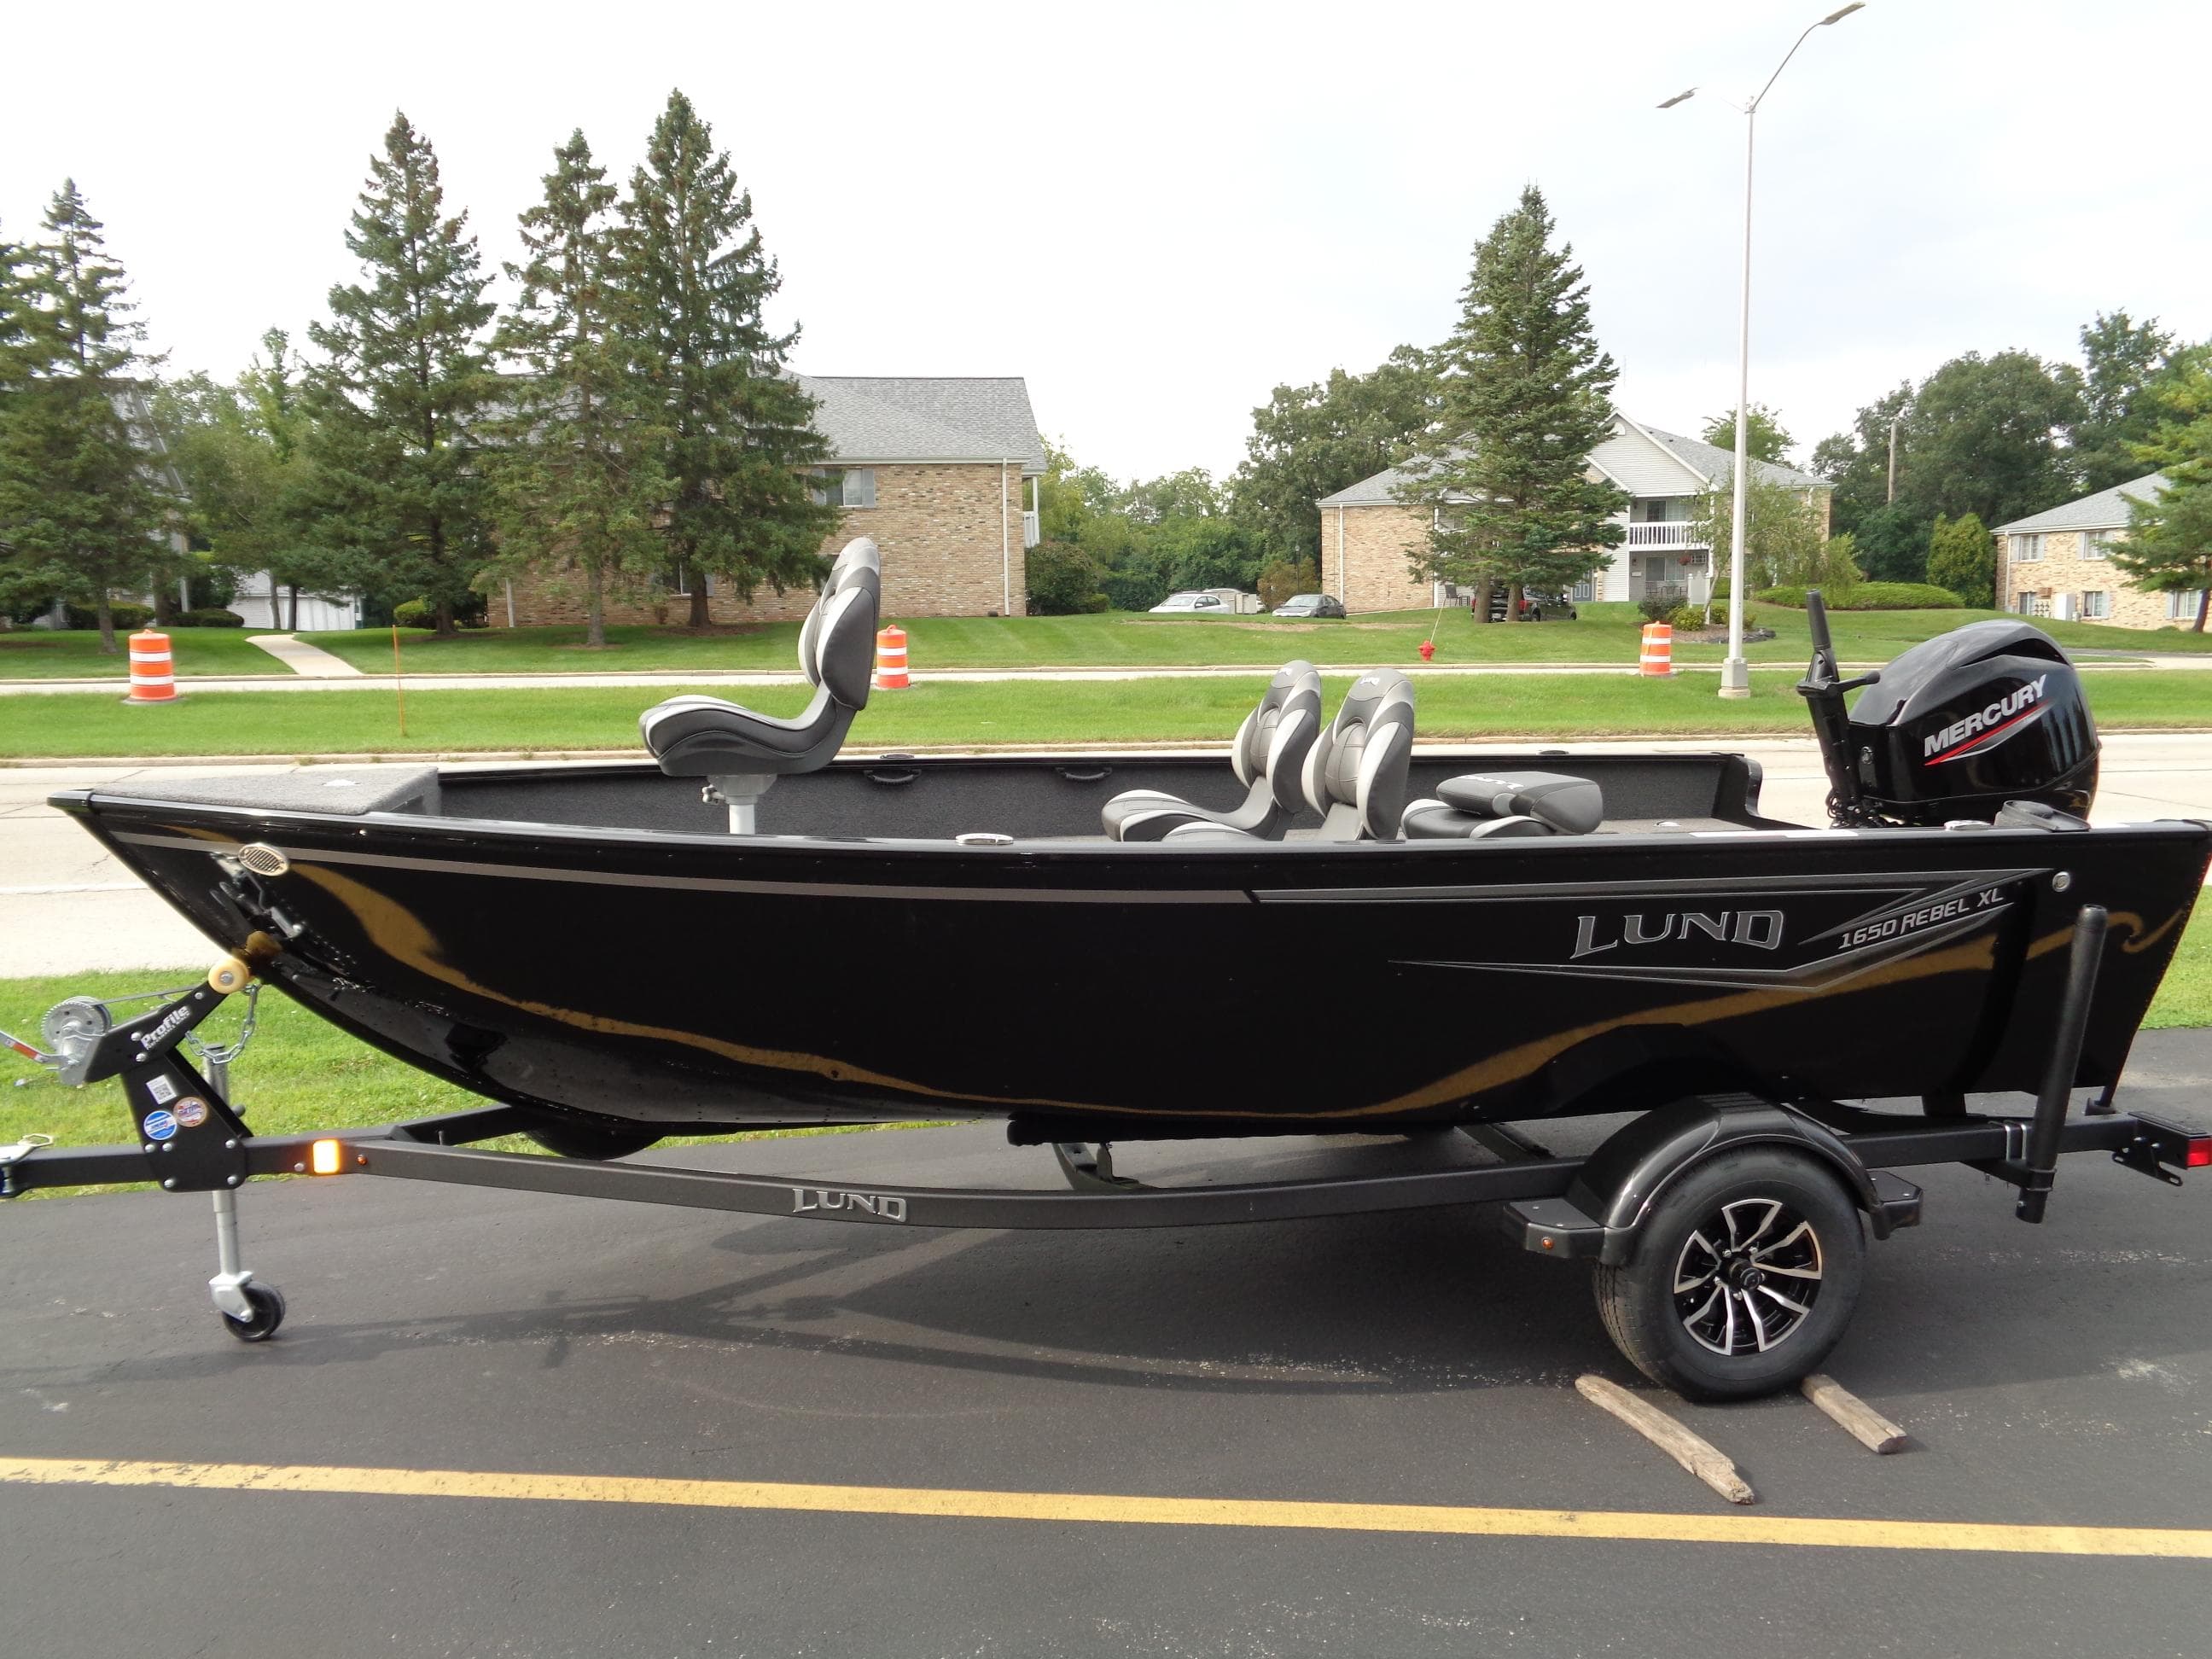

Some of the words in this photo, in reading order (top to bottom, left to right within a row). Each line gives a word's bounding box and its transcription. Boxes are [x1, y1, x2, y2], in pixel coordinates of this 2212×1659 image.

[1924, 673, 2046, 757] MERCURY
[1569, 910, 1784, 959] LUND
[1838, 920, 1896, 949] 1650
[1900, 899, 1970, 934] REBEL
[1976, 888, 2004, 907] XL
[141, 1006, 189, 1050] Profile
[792, 1188, 907, 1222] LUND
